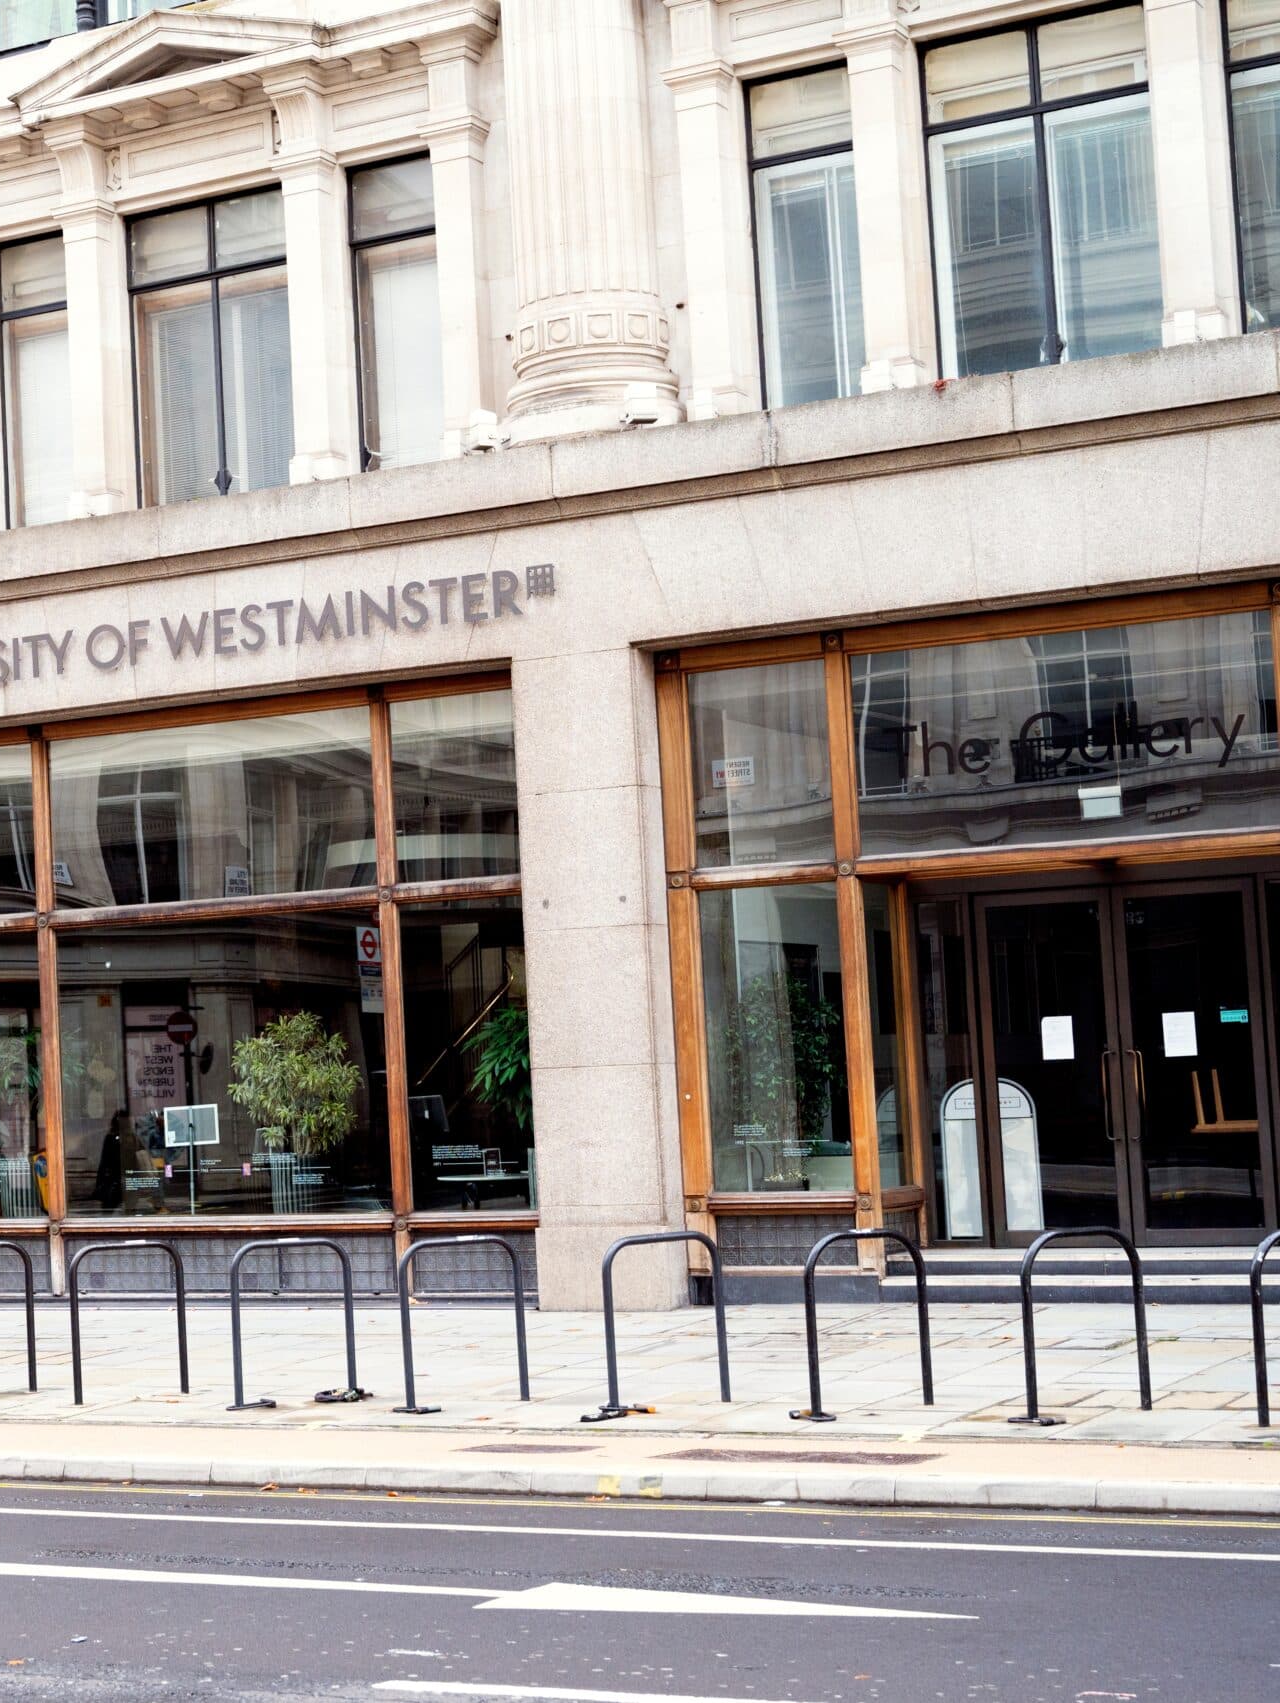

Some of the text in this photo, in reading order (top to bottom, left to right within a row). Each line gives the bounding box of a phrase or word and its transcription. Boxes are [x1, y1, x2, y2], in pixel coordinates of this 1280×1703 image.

[86, 620, 150, 670] OF
[160, 569, 523, 661] WESTMINSTER
[885, 702, 1246, 779] The Gallery
